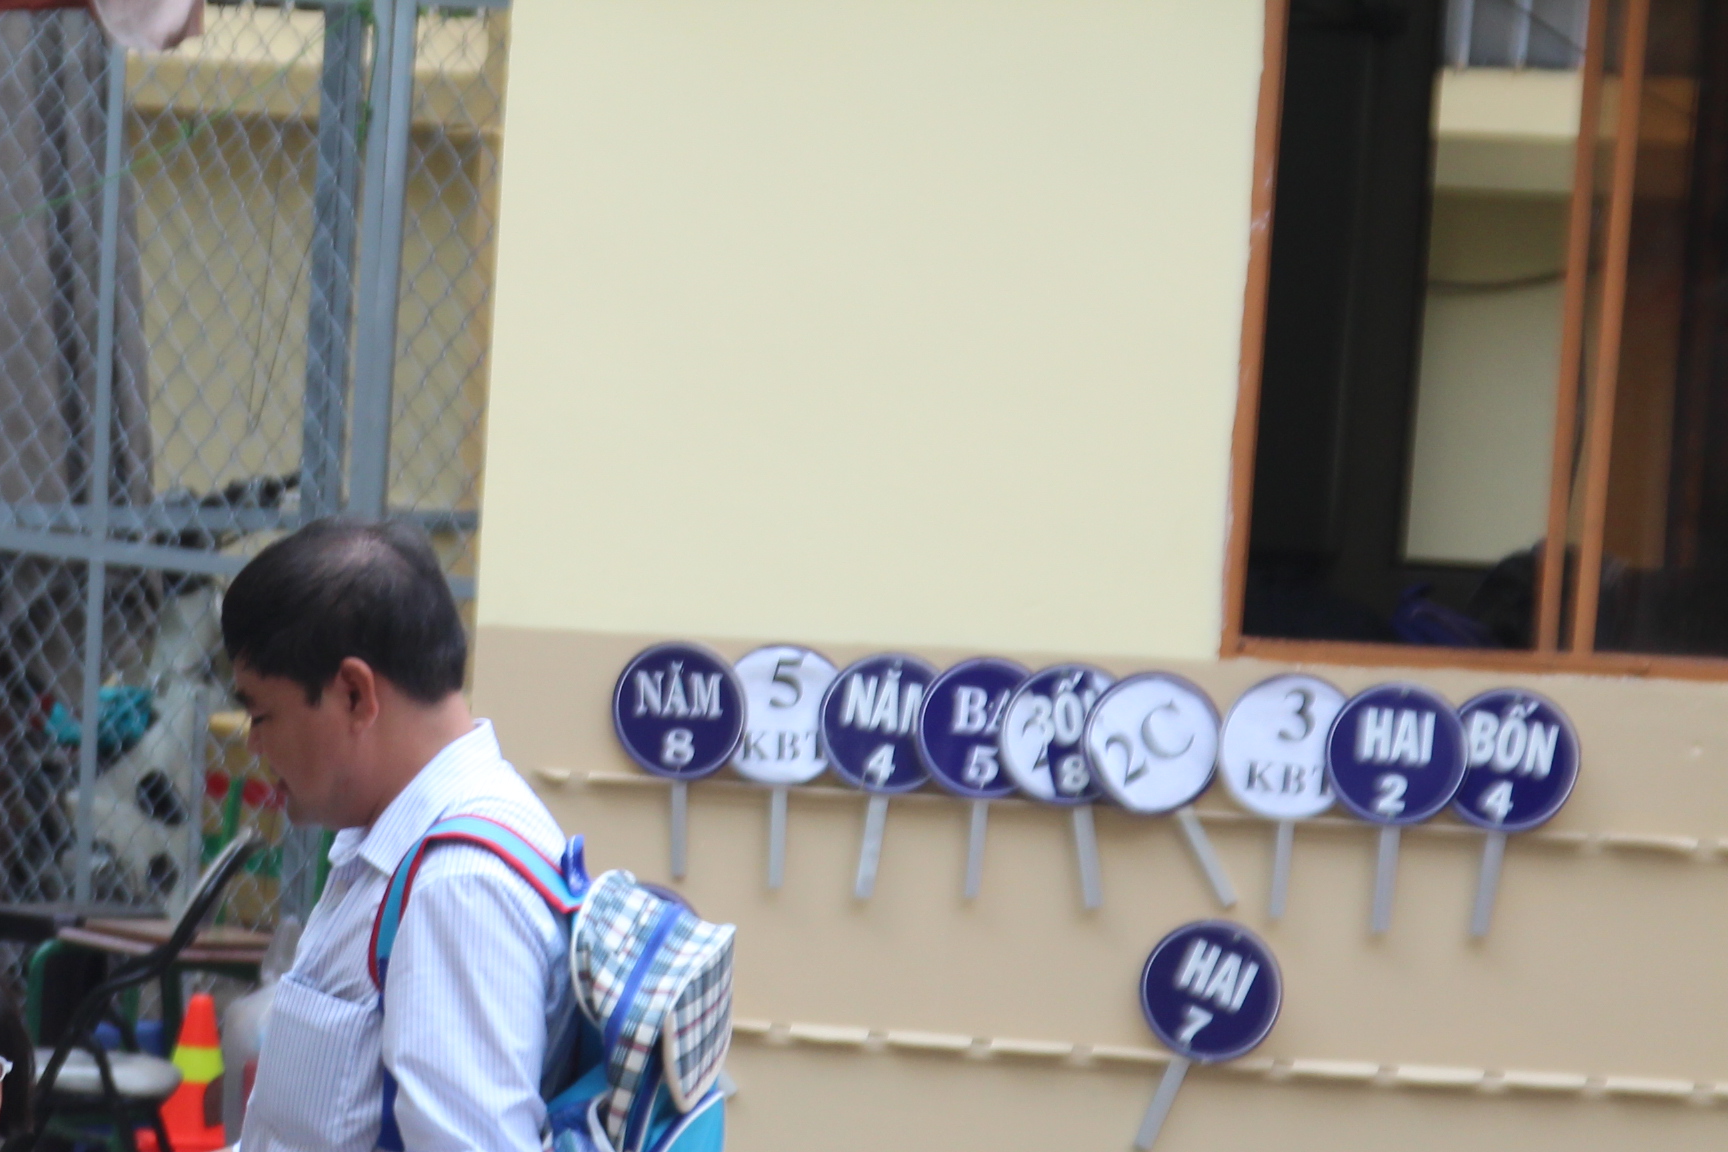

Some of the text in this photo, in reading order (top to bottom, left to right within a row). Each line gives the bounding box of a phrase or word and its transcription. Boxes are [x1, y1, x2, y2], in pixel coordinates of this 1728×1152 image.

[633, 660, 723, 718] NĂM
[769, 656, 803, 709] 5
[1277, 688, 1316, 742] 3
[1356, 706, 1437, 767] HAI
[661, 727, 695, 767] 8
[862, 744, 897, 786] 4
[963, 744, 1000, 784] 5
[1105, 698, 1198, 786] 2C
[1468, 701, 1560, 782] BỐN
[1062, 754, 1091, 794] 8
[1374, 773, 1409, 815] 2
[1479, 780, 1515, 826] 4
[1175, 937, 1260, 1015] HAI
[1177, 1004, 1214, 1045] 7
